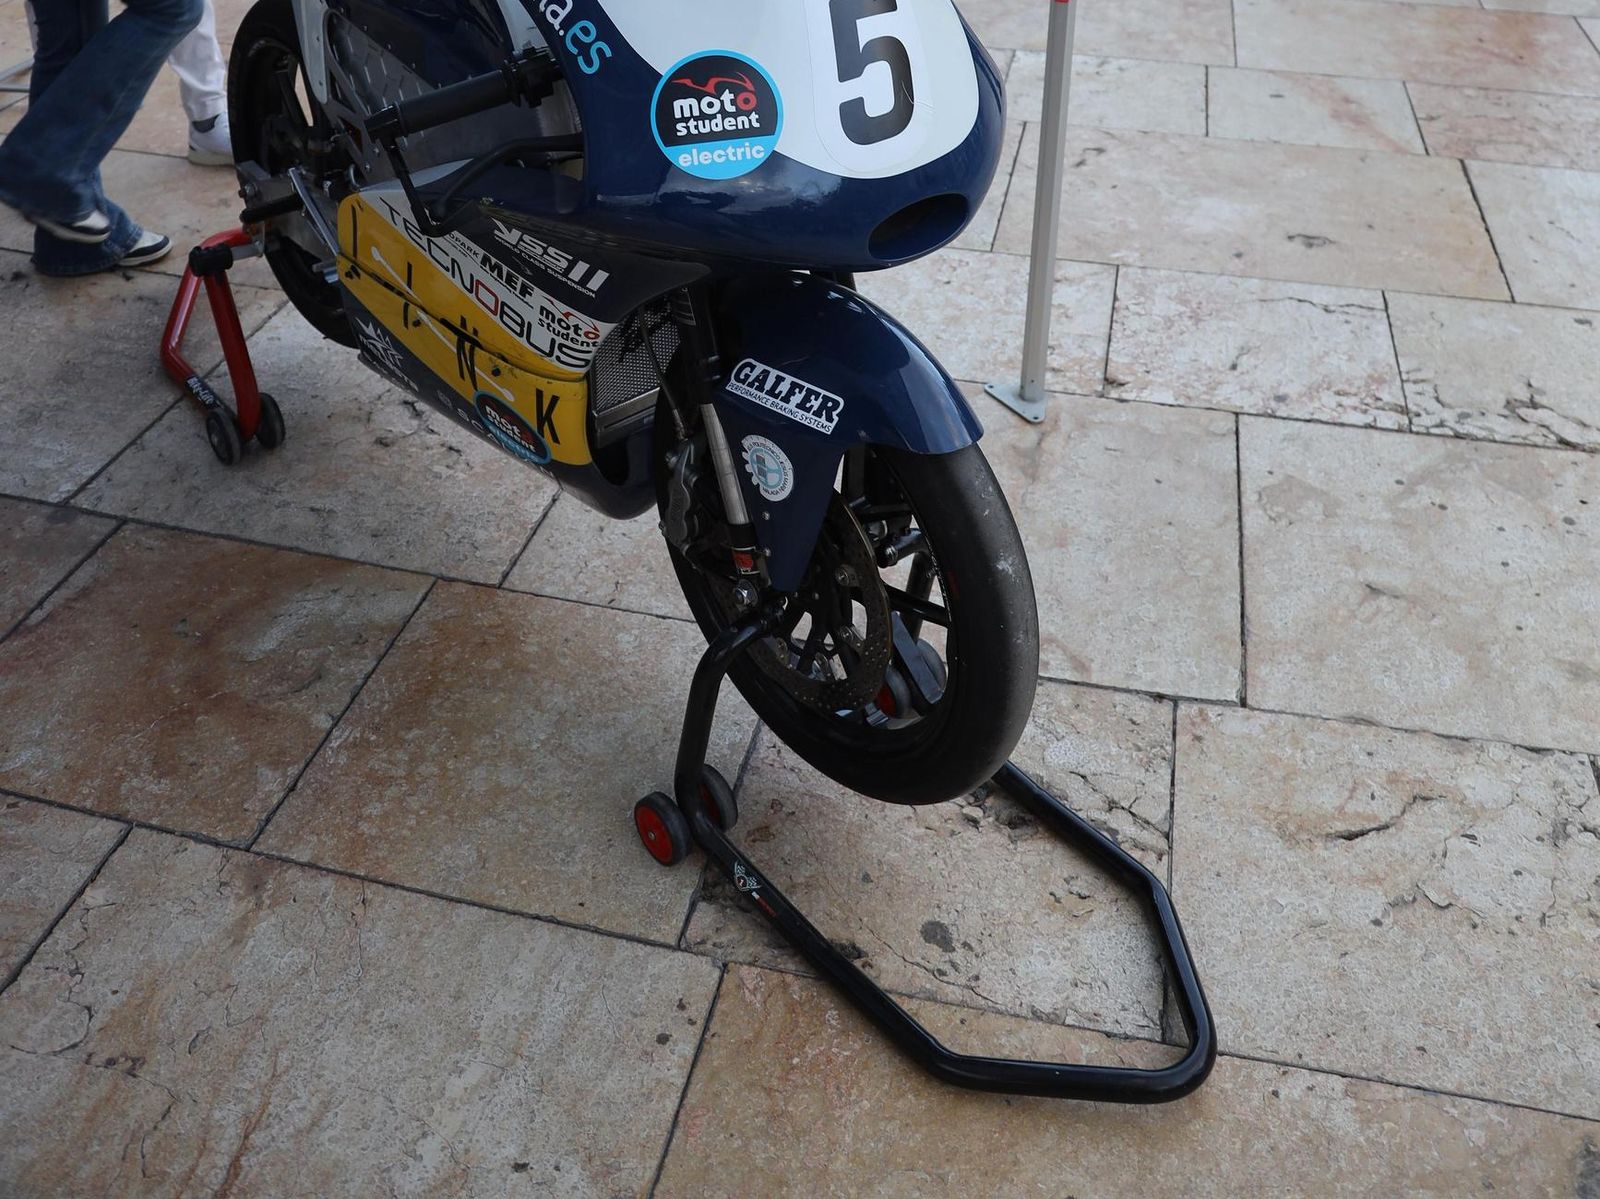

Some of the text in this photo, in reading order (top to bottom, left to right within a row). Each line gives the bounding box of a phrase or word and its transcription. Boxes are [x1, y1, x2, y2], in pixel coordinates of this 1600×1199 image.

[673, 89, 757, 119] moto
[676, 111, 761, 137] student
[678, 142, 765, 167] electric
[379, 197, 593, 368] TECNOBUS
[480, 252, 535, 299] MEF
[521, 252, 546, 271] CLASS
[546, 267, 596, 299] SUSPENSION
[538, 318, 601, 348] student
[539, 305, 600, 340] moto
[728, 383, 833, 433] PERFORMANCE BRAKING SYSTEMS
[734, 361, 841, 424] GALFER
